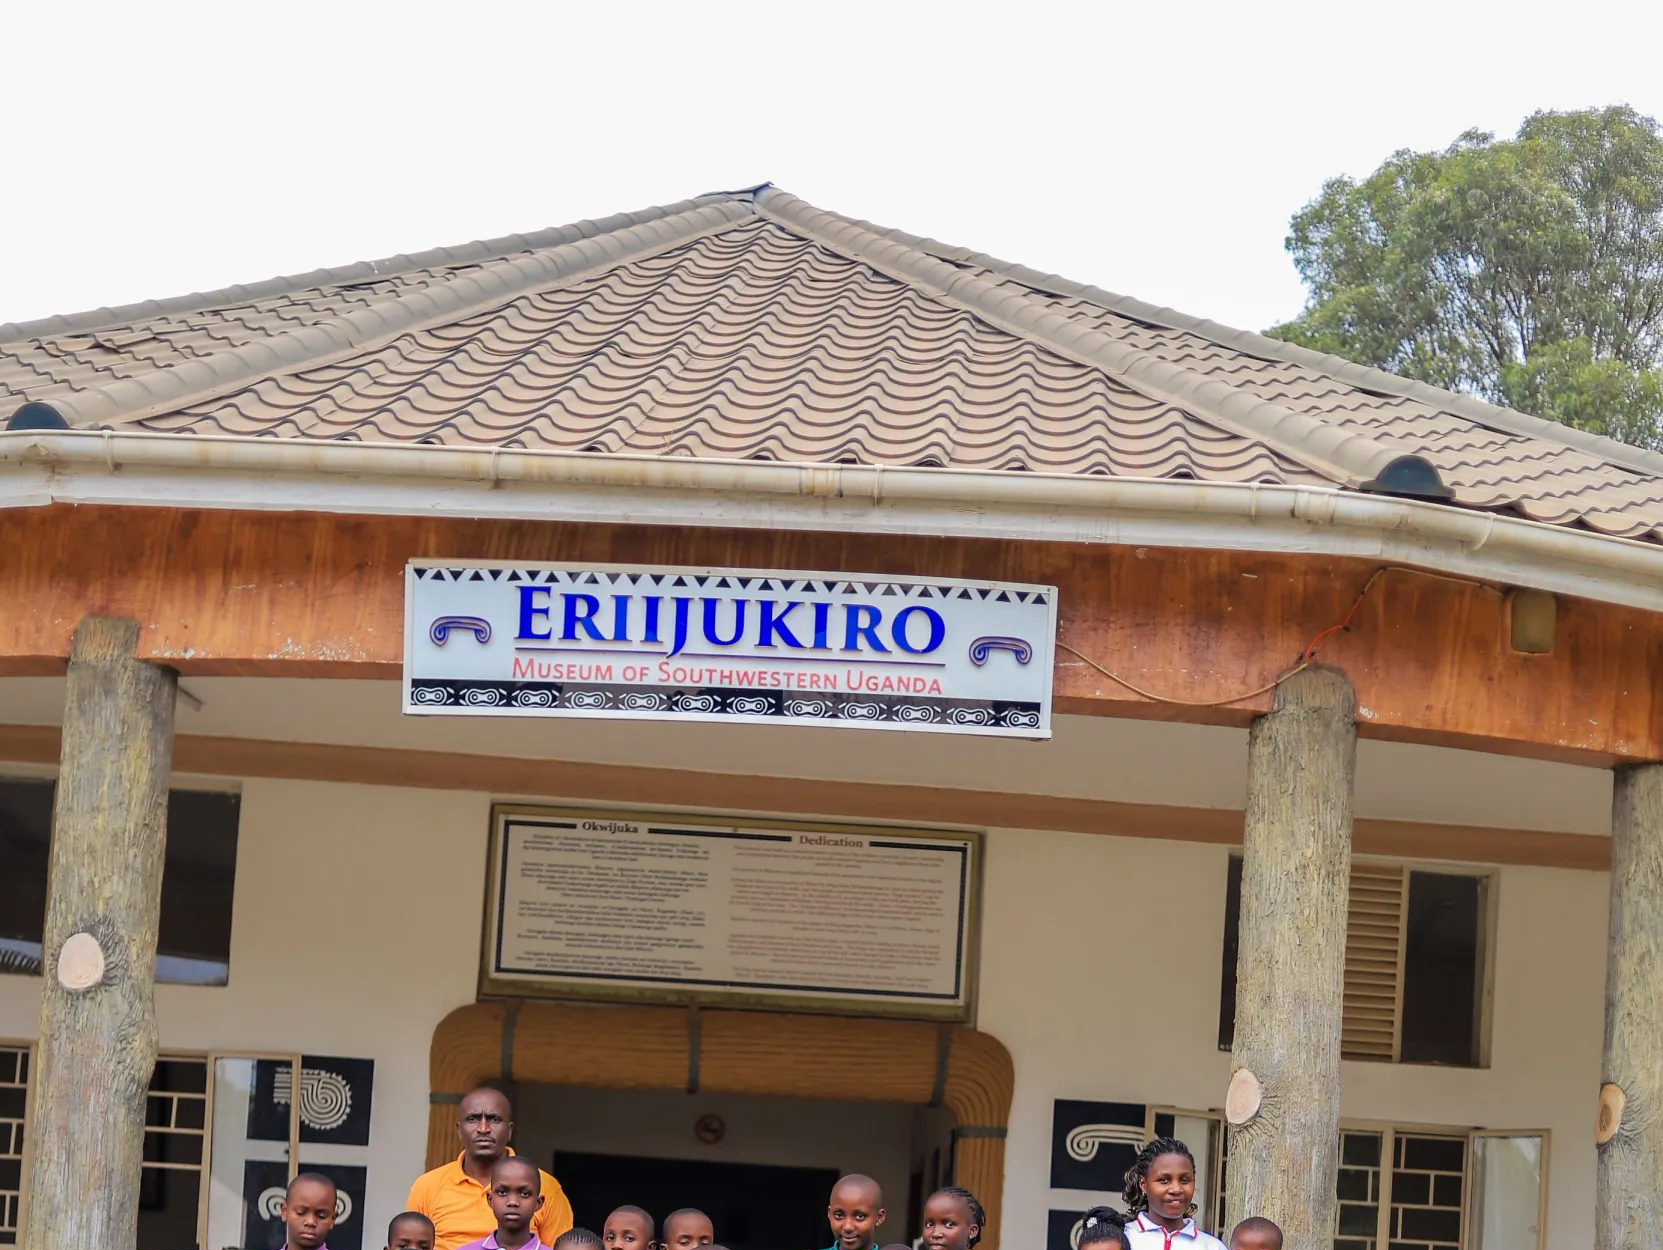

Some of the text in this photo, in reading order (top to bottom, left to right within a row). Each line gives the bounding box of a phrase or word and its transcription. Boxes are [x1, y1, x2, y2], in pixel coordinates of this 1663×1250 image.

[514, 585, 946, 658] ERIIJUKIRO
[512, 657, 942, 694] MUSEUM OF SOUTHWESTERN UGANDA
[582, 820, 639, 835] Okwijuka
[799, 834, 864, 849] Dedication
